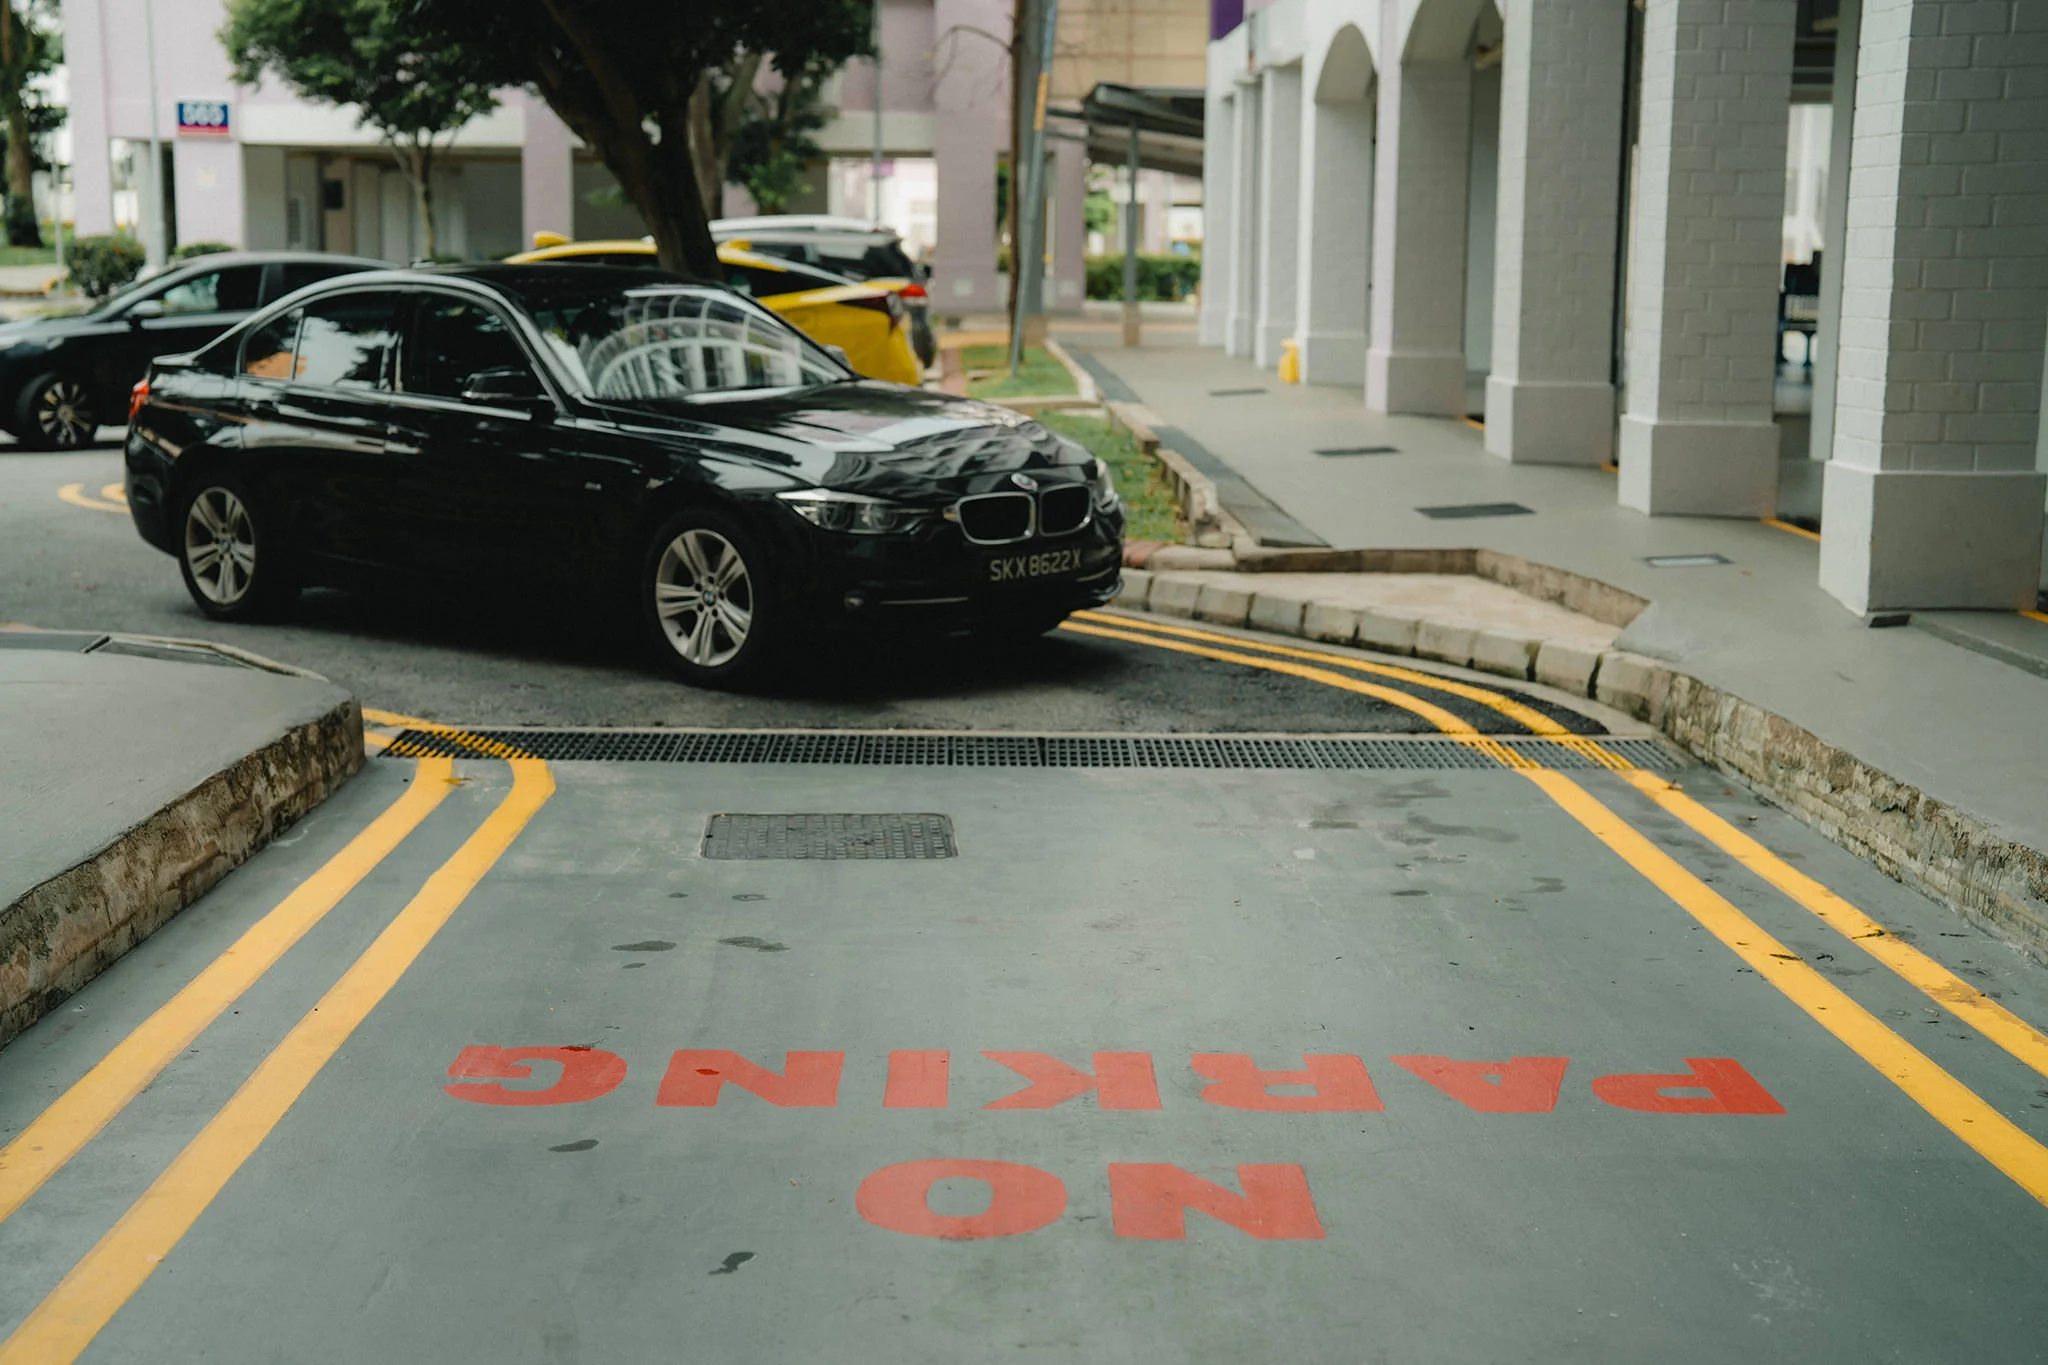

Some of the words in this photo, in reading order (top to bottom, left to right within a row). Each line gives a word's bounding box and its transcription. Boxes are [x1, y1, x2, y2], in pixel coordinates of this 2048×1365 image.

[989, 547, 1082, 581] SKX8622X
[443, 1045, 1788, 1115] PARKING
[855, 1158, 1326, 1240] NO
